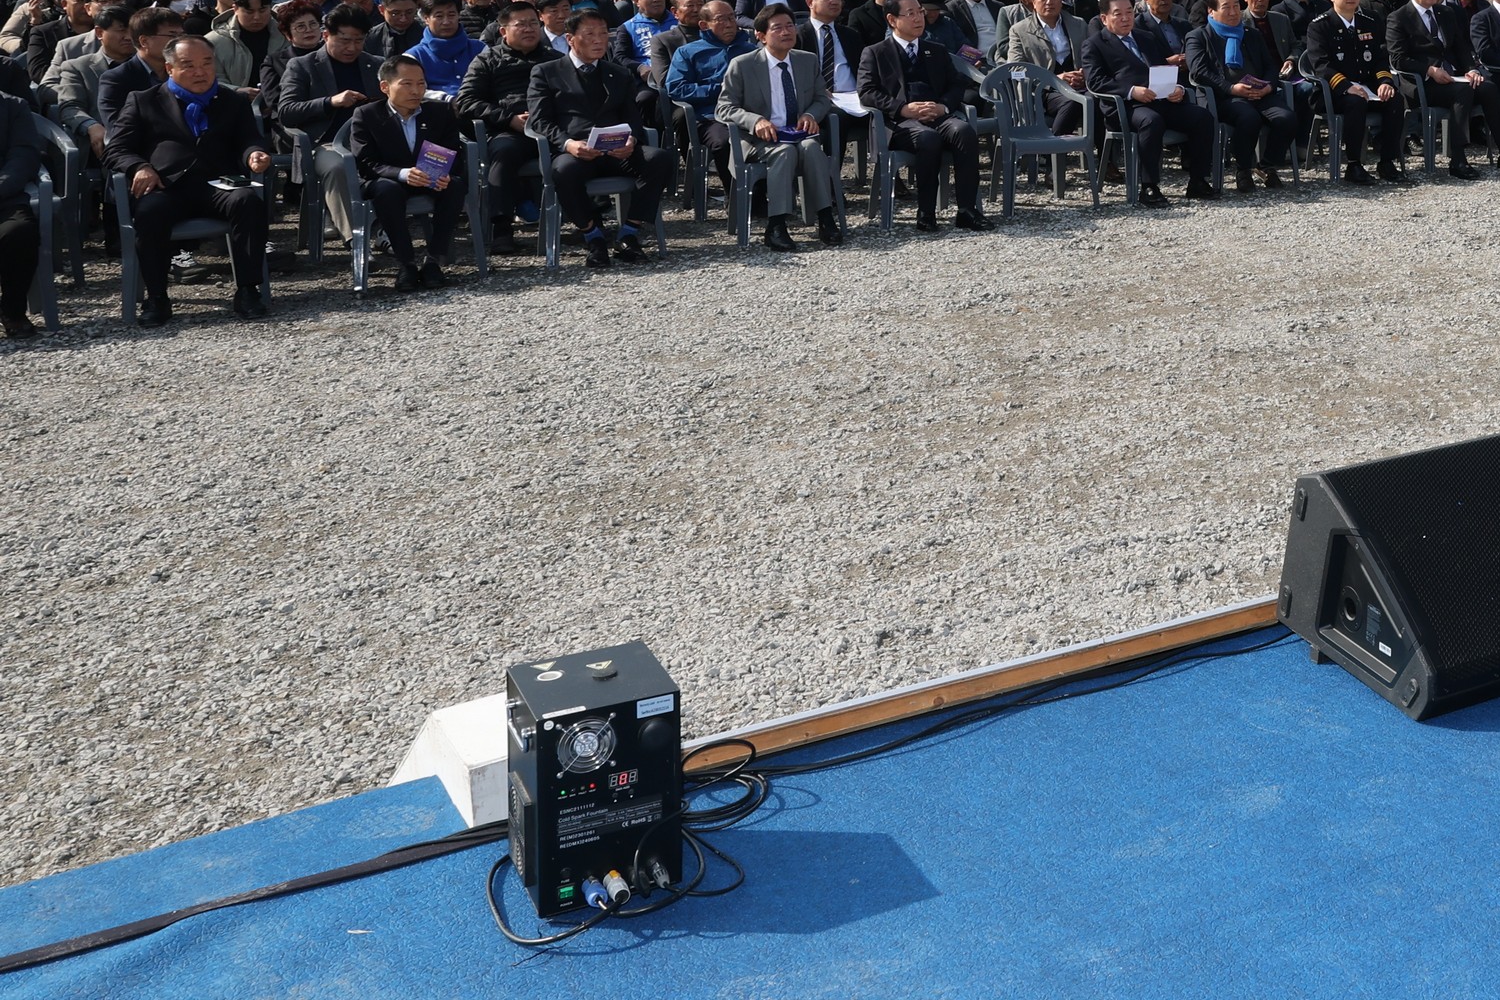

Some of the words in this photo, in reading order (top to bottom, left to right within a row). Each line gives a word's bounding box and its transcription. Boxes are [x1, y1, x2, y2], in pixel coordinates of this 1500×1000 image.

[558, 815, 571, 823] Cold
[571, 813, 585, 821] Spark
[586, 808, 608, 817] Fountain
